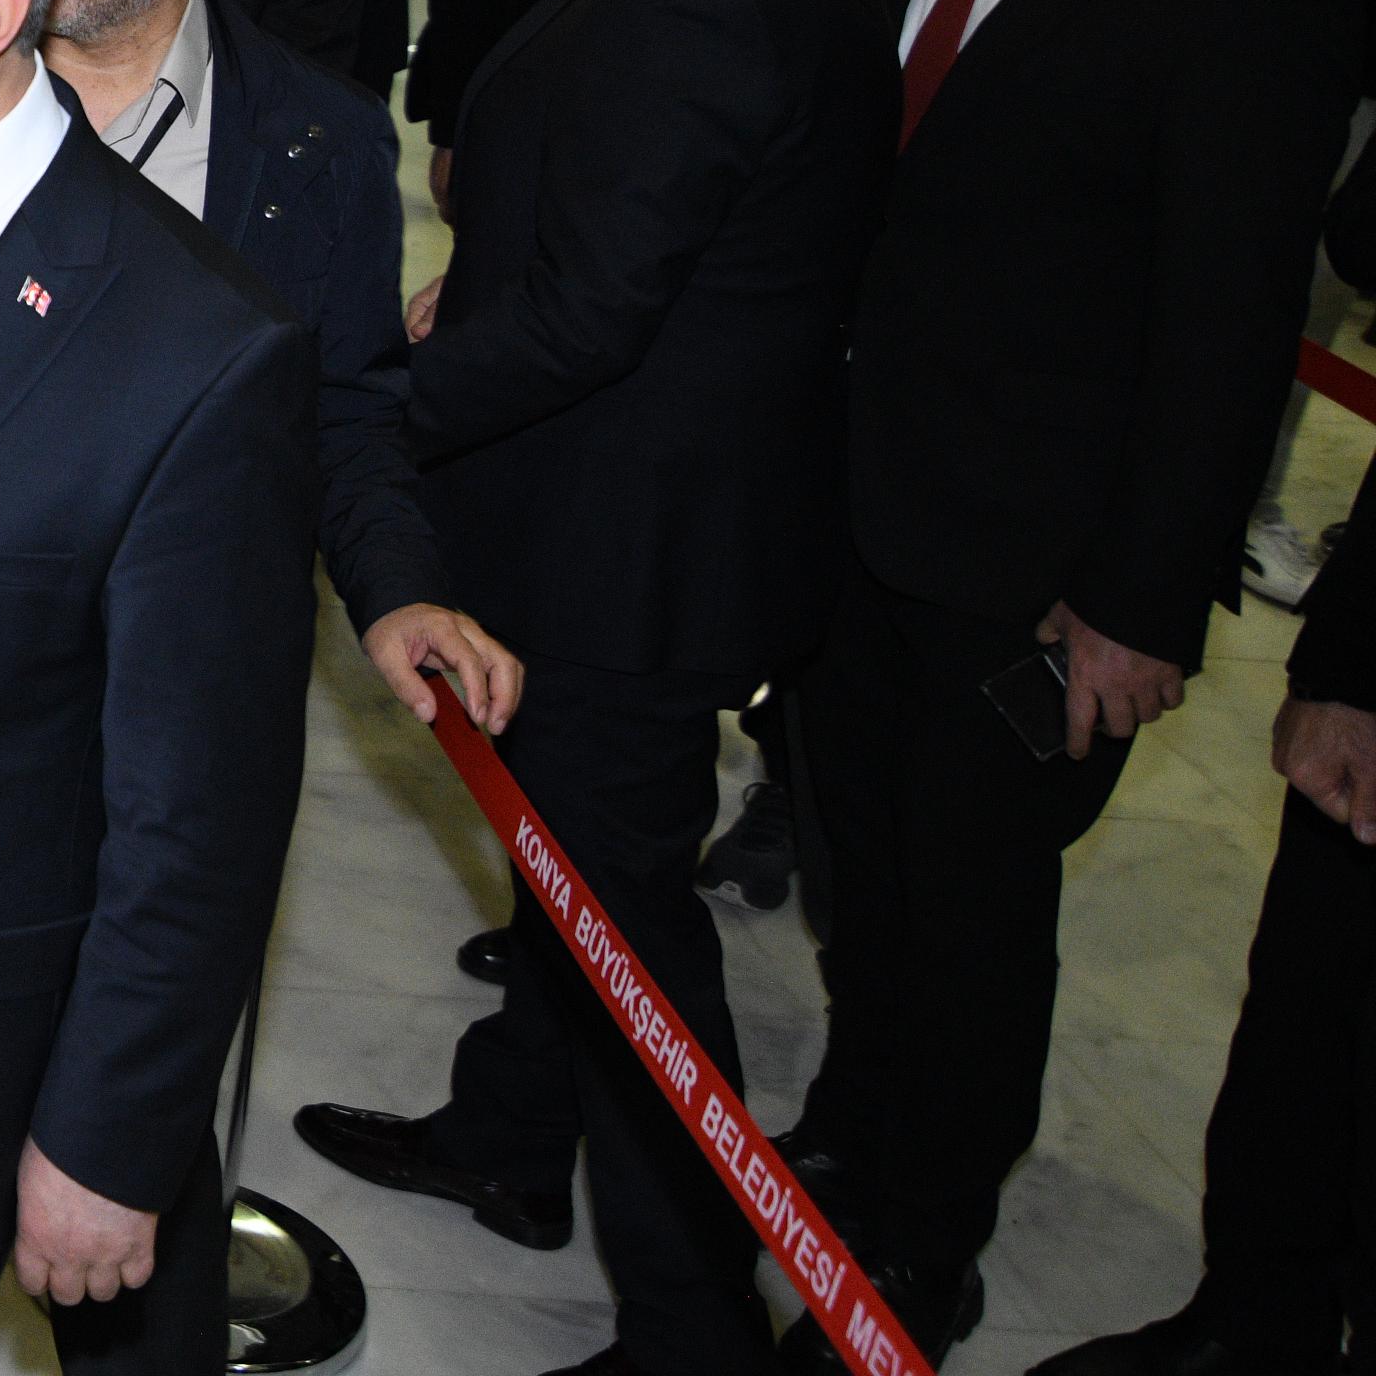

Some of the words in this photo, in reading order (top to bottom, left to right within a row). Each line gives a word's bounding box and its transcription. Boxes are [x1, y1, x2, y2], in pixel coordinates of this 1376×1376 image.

[515, 815, 572, 921] KONYA
[574, 905, 698, 1106] BÜYÜKŞEHİR
[701, 1092, 847, 1312] BELEDİYESİ
